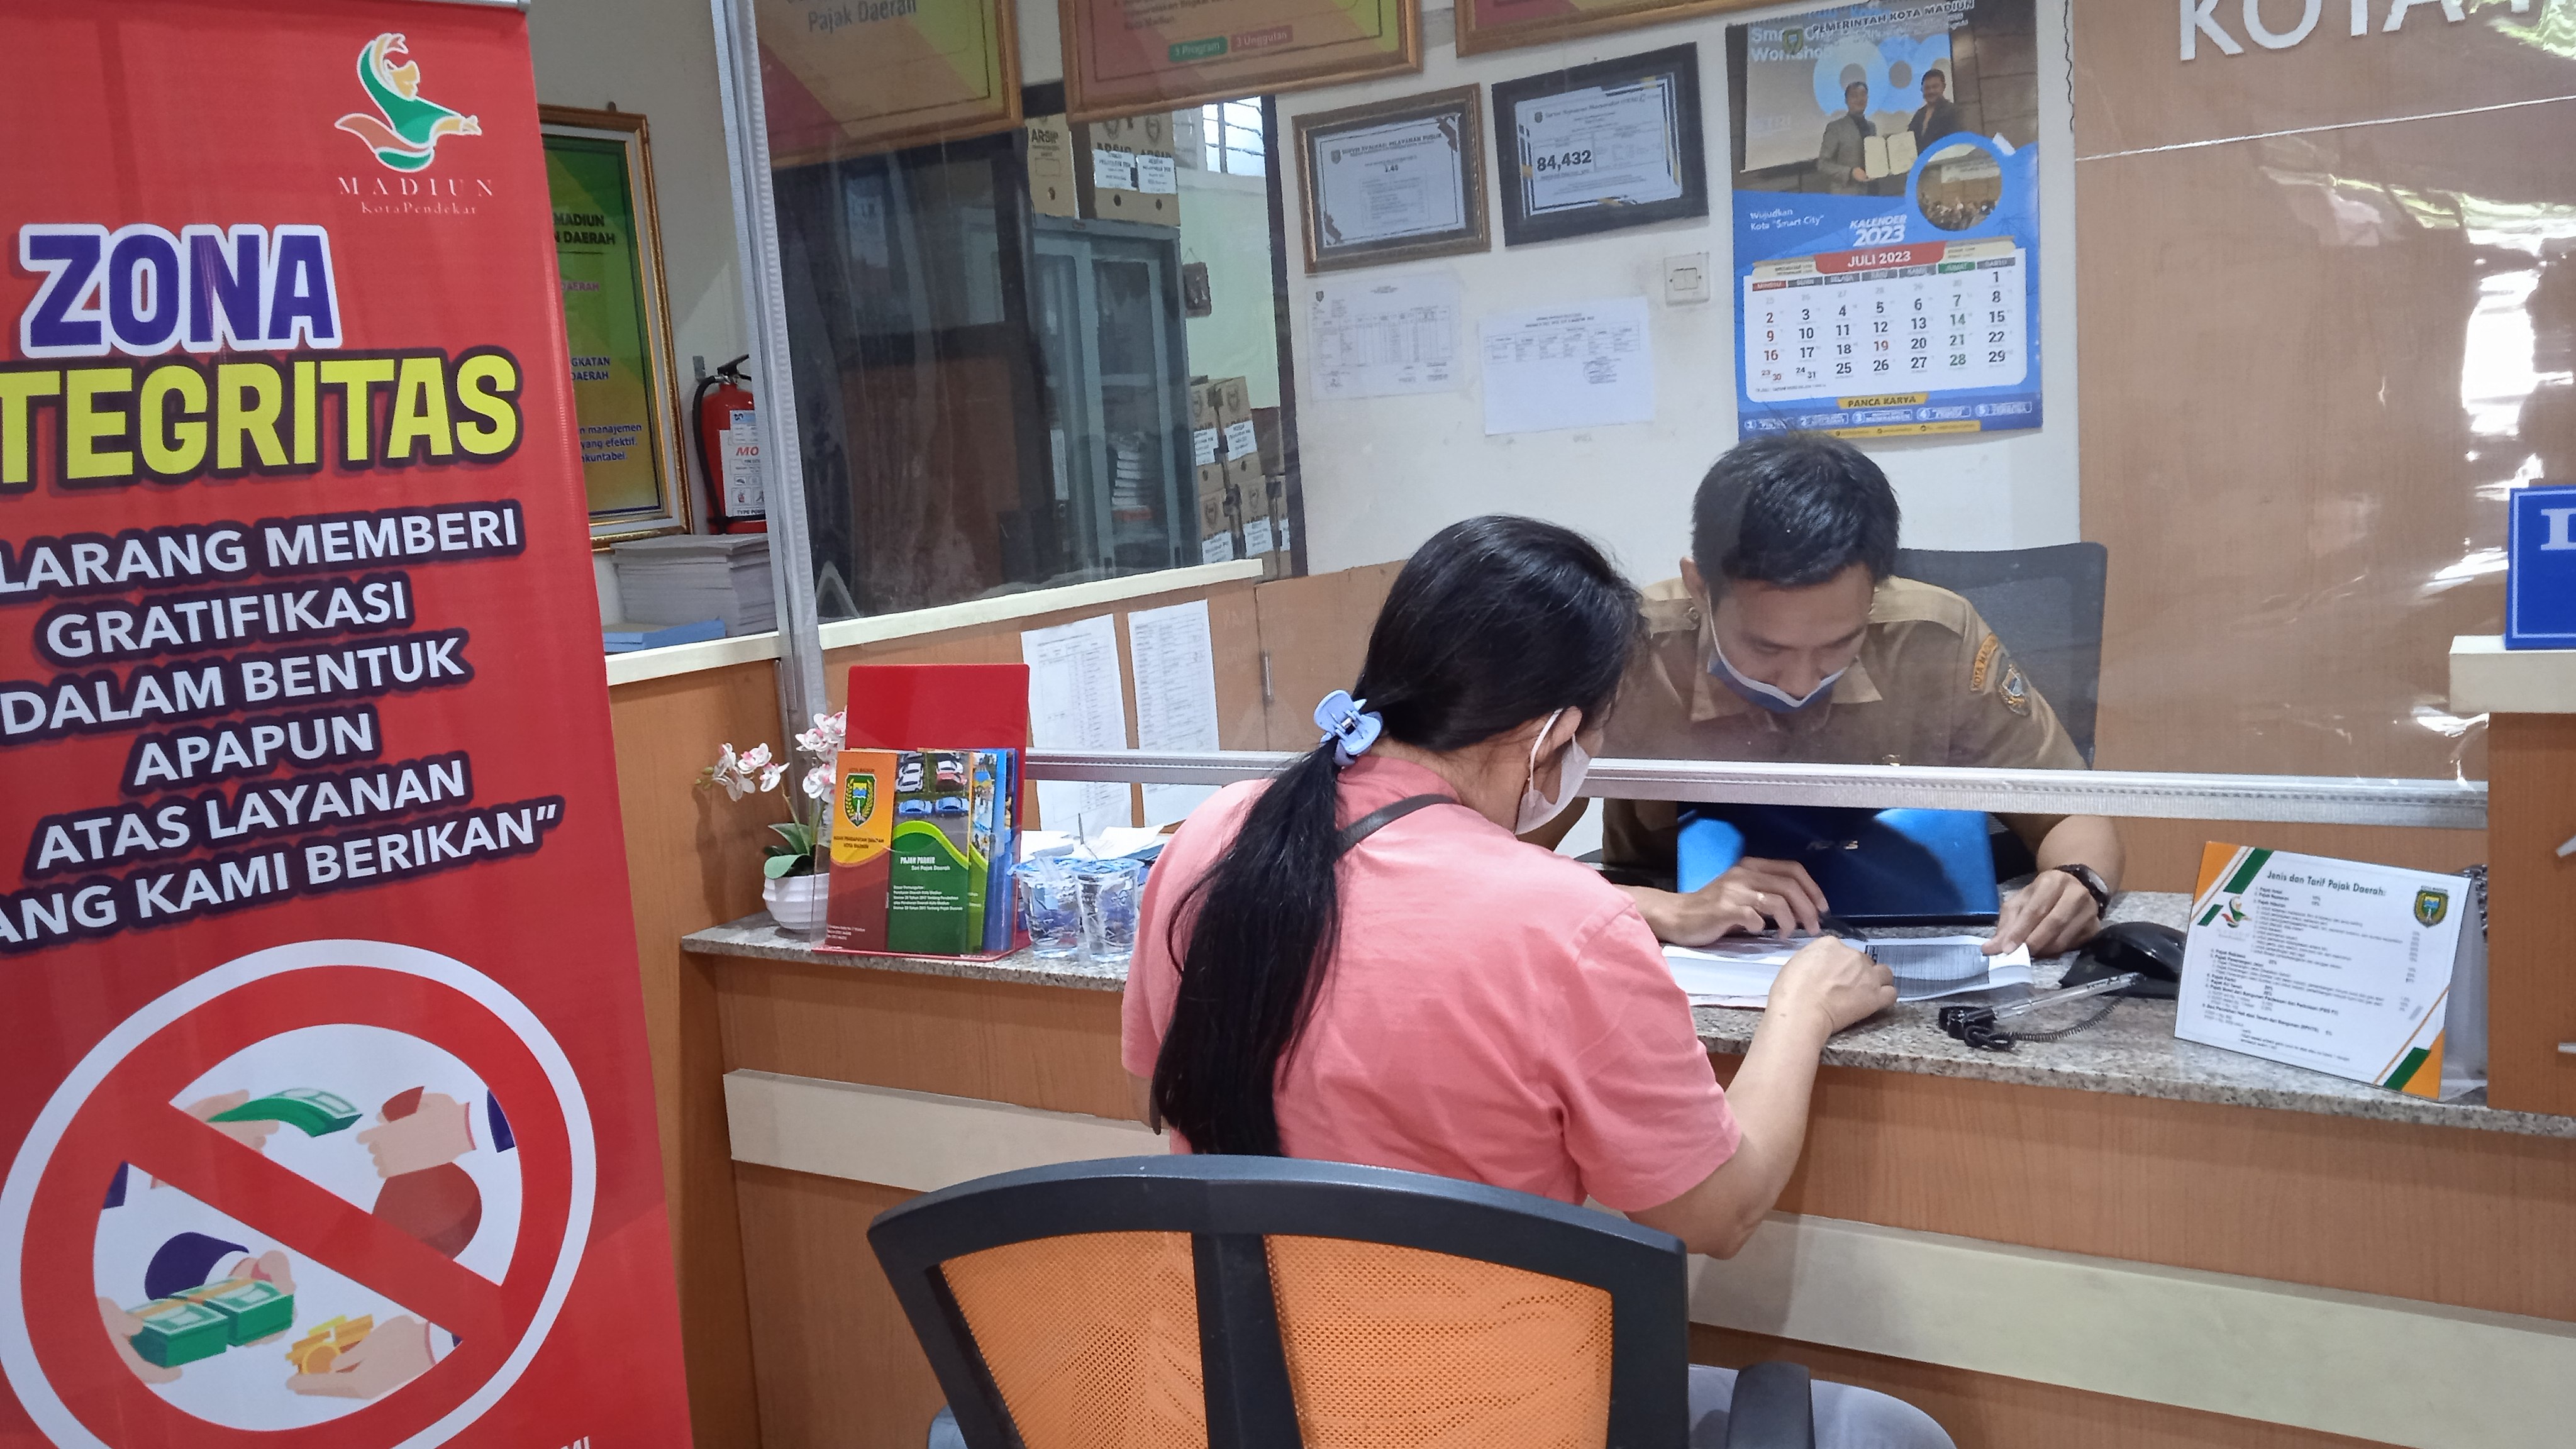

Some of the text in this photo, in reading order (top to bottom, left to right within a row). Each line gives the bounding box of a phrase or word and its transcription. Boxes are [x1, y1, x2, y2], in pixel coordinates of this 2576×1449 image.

[808, 0, 916, 34] Pajak Daerah
[1813, 0, 1975, 33] PEMERINTAH KOTA MADIUN
[1182, 42, 1219, 55] Program
[1243, 32, 1287, 47] Unggulan
[1031, 127, 1058, 144] ARSIP
[1536, 149, 1592, 172] 84,432
[338, 177, 492, 196] MADIUN
[553, 211, 606, 227] MADIUN
[1750, 208, 1793, 220] Wujudkan
[1850, 214, 1907, 229] KALENDER
[564, 230, 616, 245] DAERAH
[1750, 221, 1770, 231] Kota
[1853, 225, 1906, 247] 2023
[1847, 251, 1911, 267] JULI 2023
[1992, 271, 1999, 283] 1
[28, 234, 337, 348] ZONA
[1766, 291, 2001, 323] 2 3 4 5 6 7 8
[1767, 311, 2005, 341] 9 10 11 12 13 14 15
[1764, 331, 2004, 361] 16 17 18 19 20 21 22
[1836, 362, 1852, 374] 25
[1873, 360, 1889, 371] 26
[1911, 357, 1927, 369] 27
[1950, 353, 1966, 365] 28
[1989, 351, 2006, 362] 29
[1848, 395, 1916, 408] PANCA KARYA
[0, 354, 518, 485] TEGRITAS
[588, 423, 642, 435] manajemen
[0, 508, 518, 593] LARANG MEMBERI
[46, 581, 407, 658] GRATIFIKASI
[1, 637, 465, 736] DALAM BENTUK
[133, 714, 374, 786] APAPUN
[36, 759, 466, 870] ATAS LAYANAN
[135, 852, 287, 920] KAMI
[2267, 870, 2387, 897] Jenis dan Tarif Pajak Daerah:
